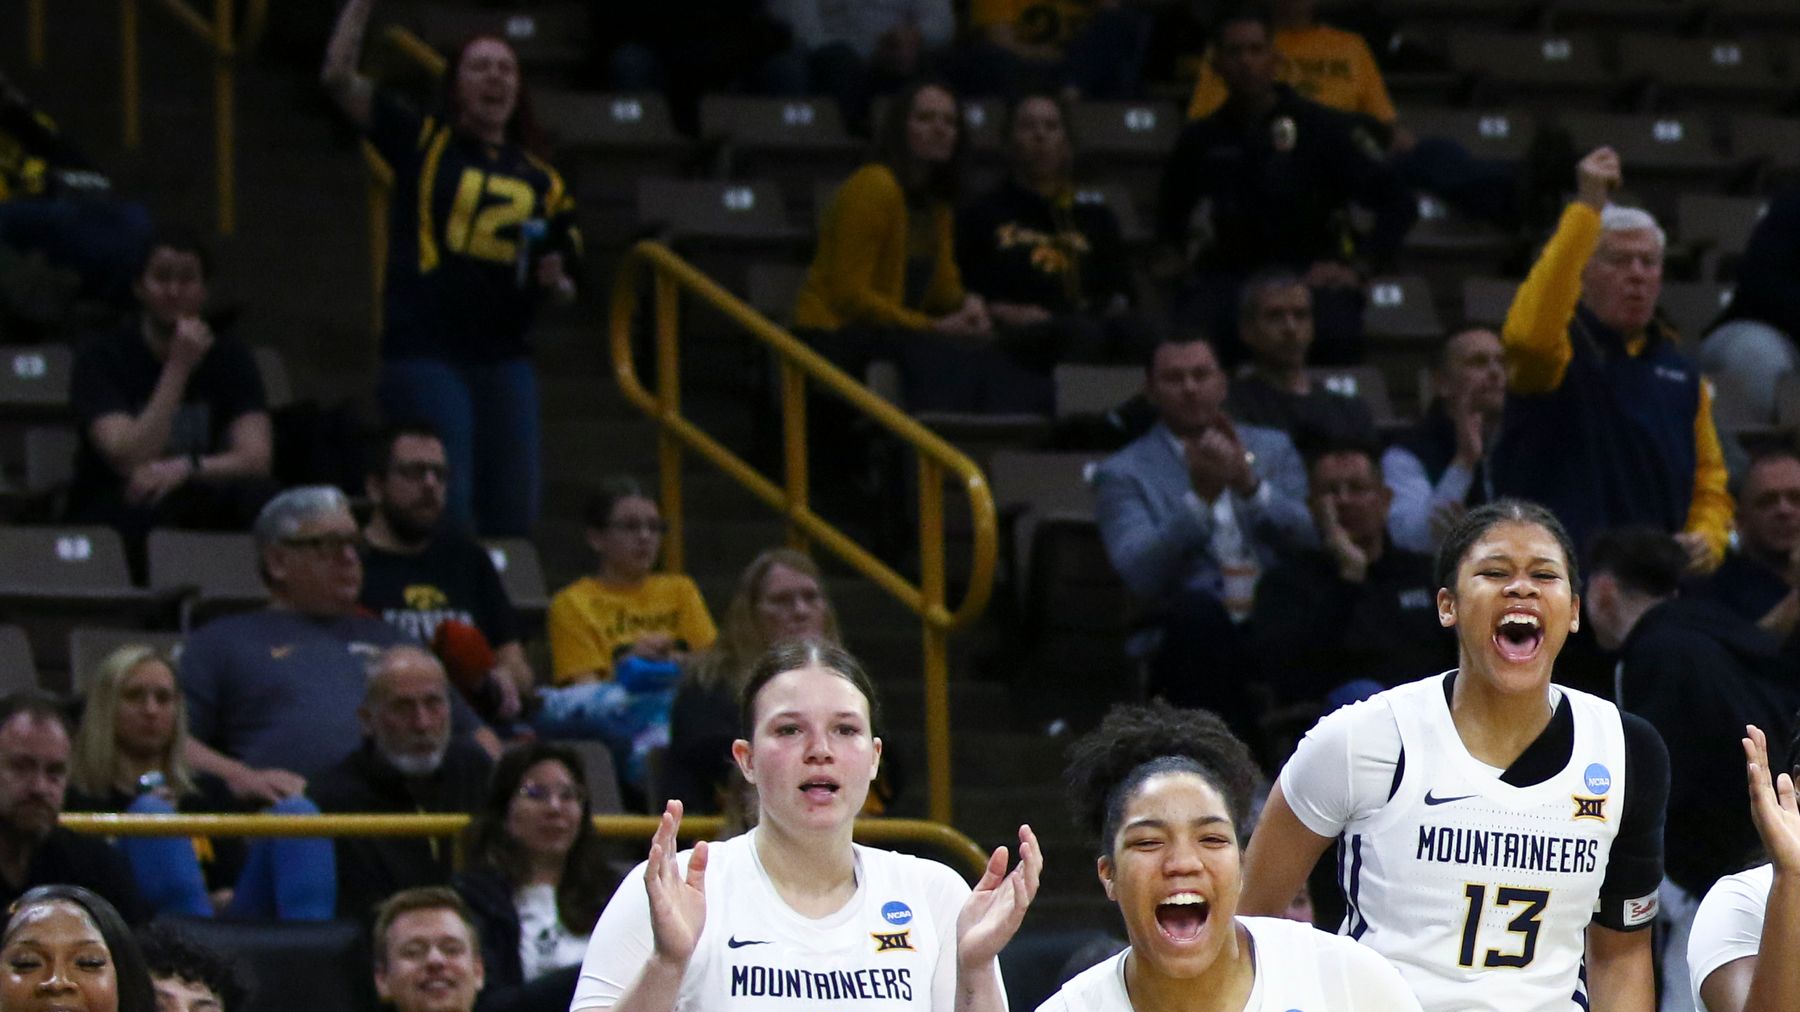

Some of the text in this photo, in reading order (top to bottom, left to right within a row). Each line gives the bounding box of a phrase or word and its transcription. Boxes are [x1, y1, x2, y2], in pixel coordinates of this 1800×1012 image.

[446, 166, 535, 265] 12
[1416, 825, 1599, 873] MOUNTAINEERS
[1456, 881, 1553, 969] 13
[731, 965, 913, 1001] MOUNTAINEERS
